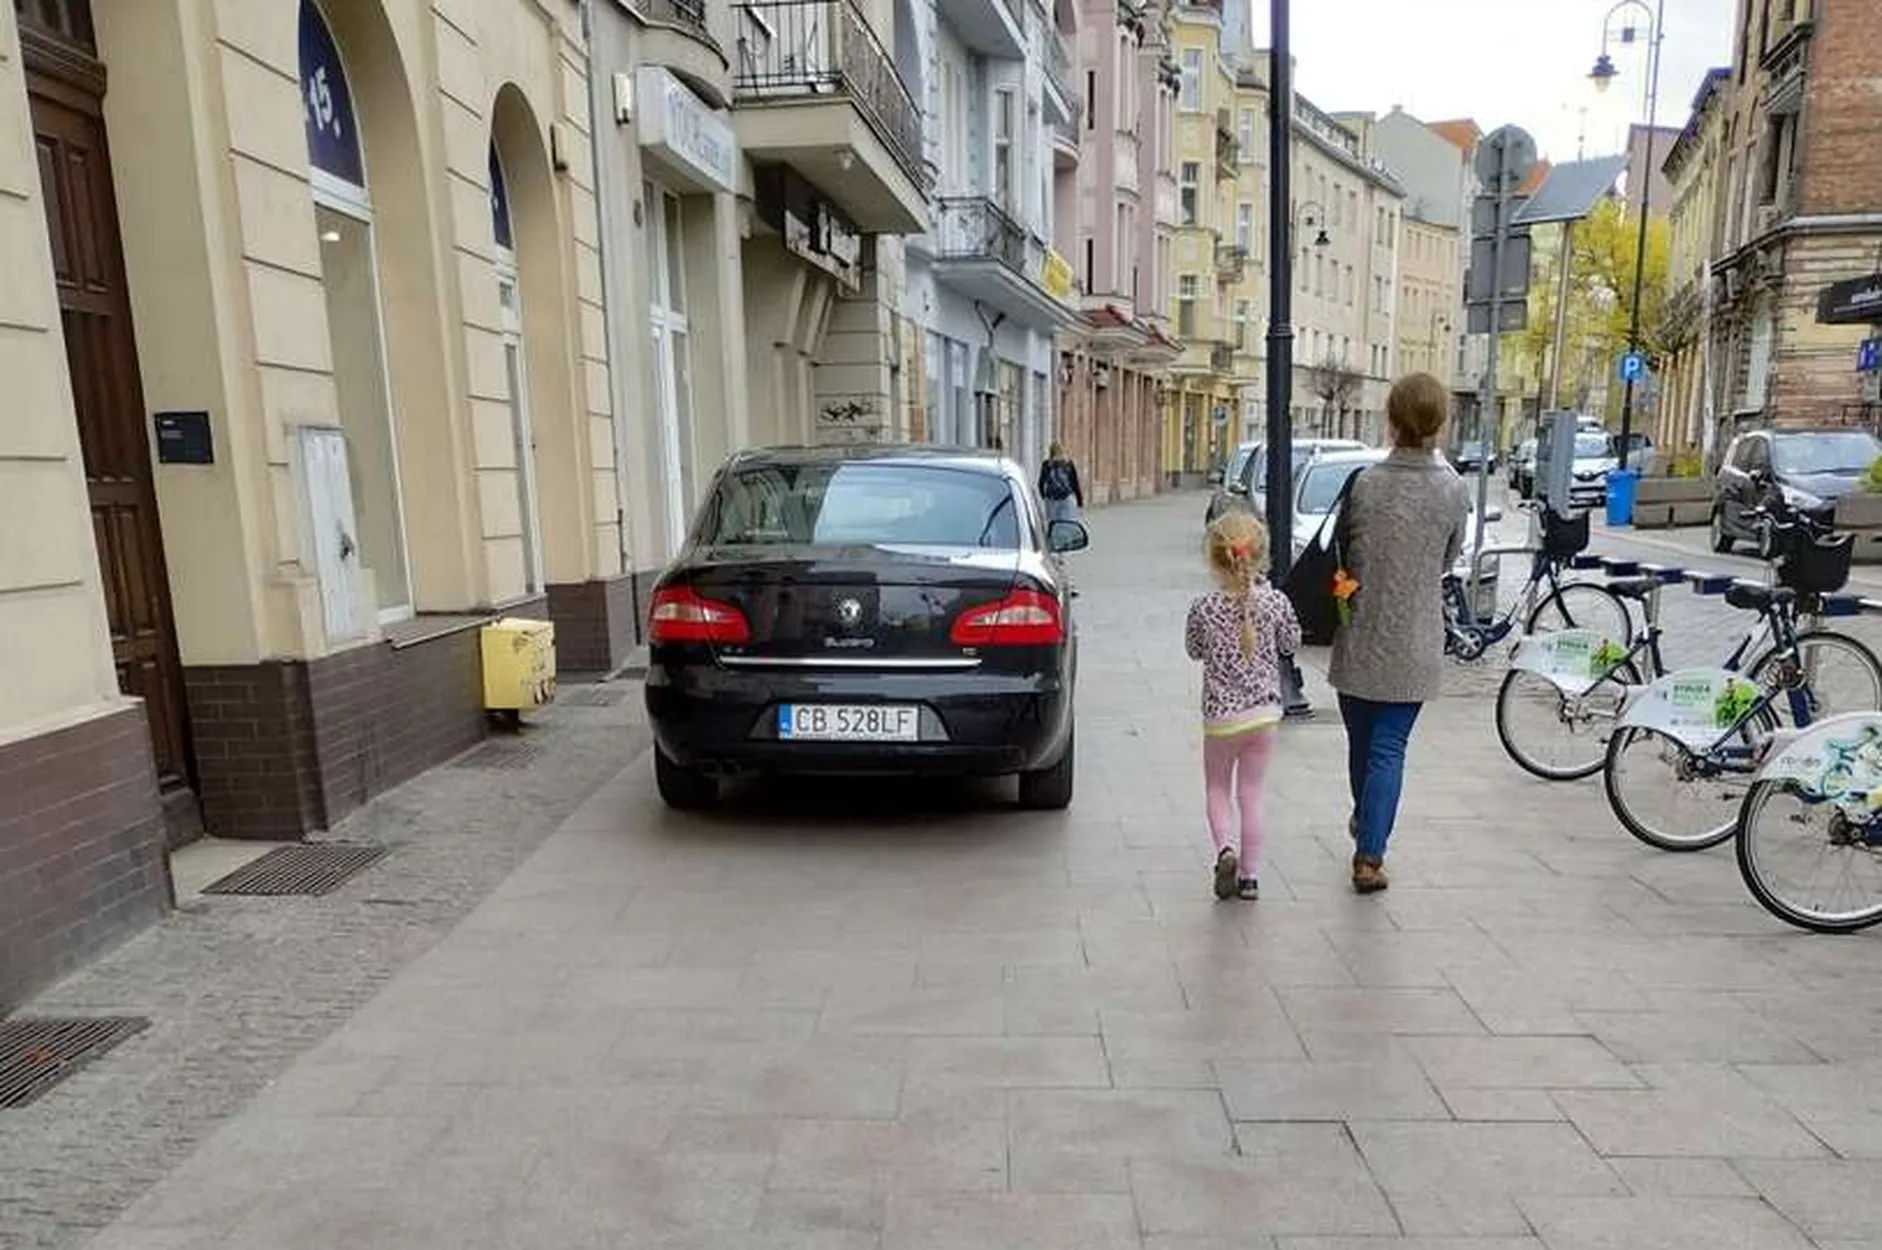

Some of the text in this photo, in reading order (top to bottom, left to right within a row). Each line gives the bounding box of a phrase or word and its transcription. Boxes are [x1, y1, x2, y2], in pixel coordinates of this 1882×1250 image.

[1625, 357, 1640, 378] P
[796, 707, 912, 732] CB 528LF
